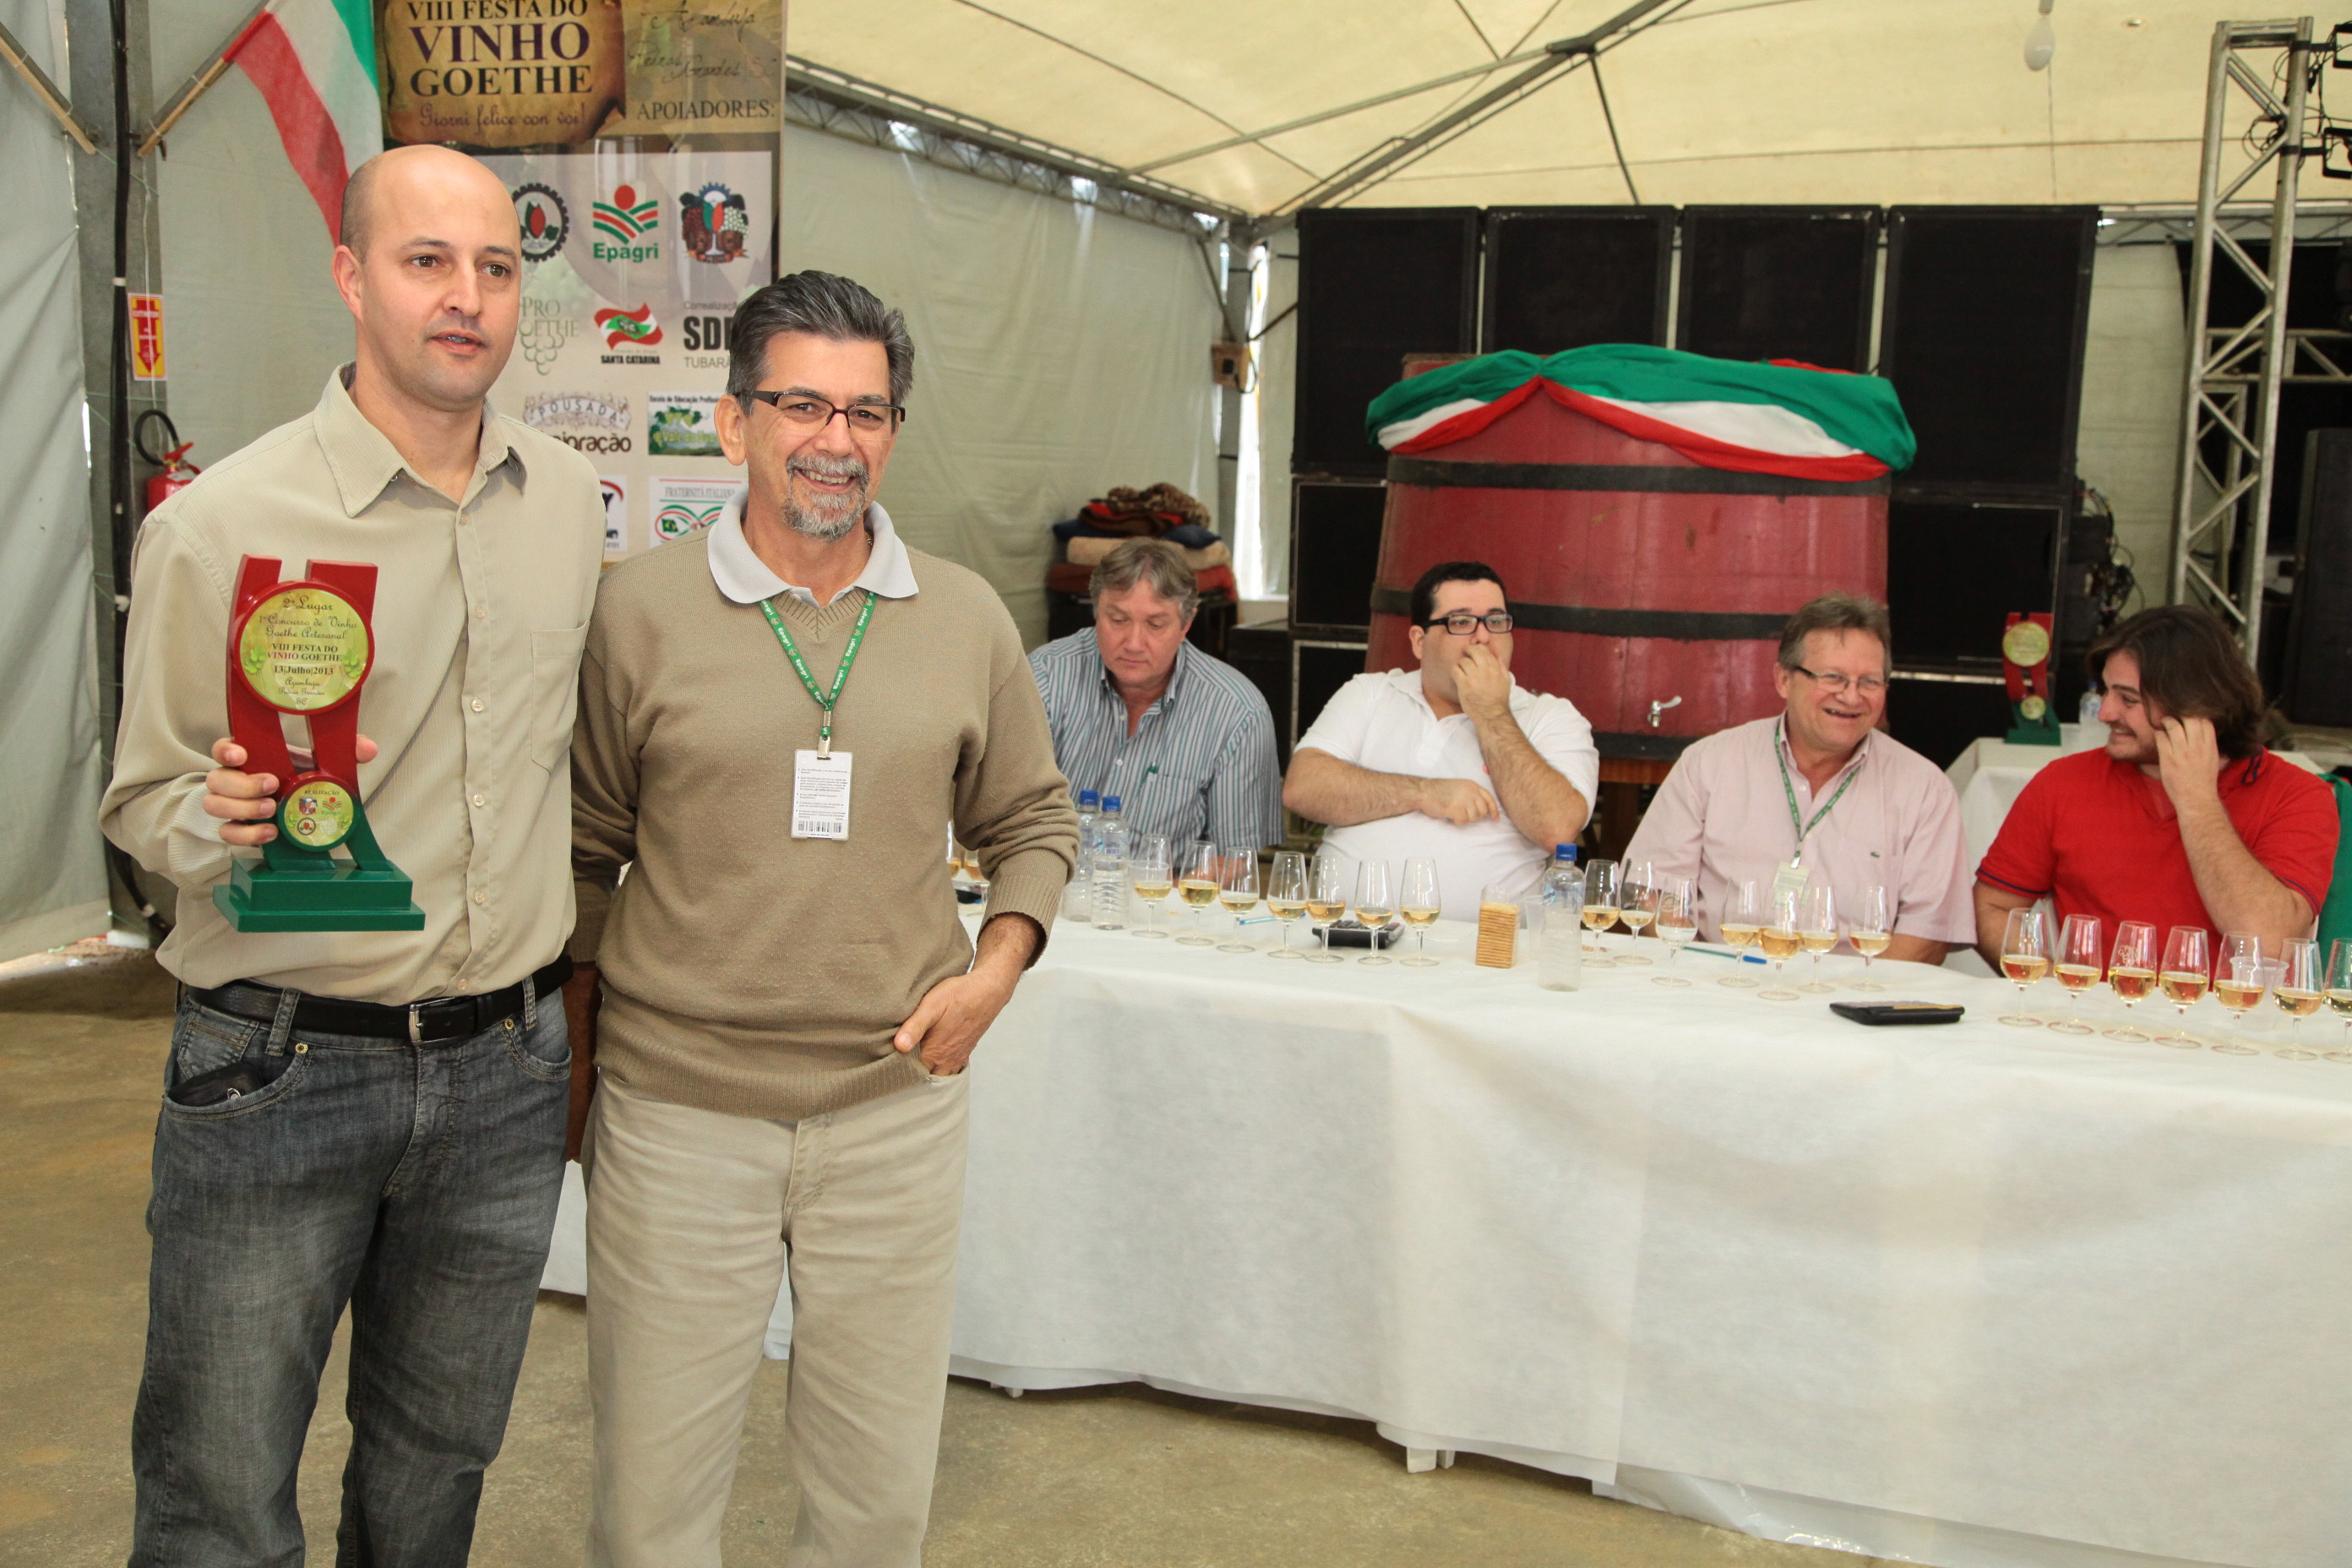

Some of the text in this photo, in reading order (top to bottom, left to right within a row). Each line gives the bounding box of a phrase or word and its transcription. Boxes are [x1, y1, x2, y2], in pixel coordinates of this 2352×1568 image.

[408, 0, 589, 21] VIII FESTA DO
[410, 21, 590, 64] VINHO
[411, 65, 593, 96] GOETHE
[420, 103, 470, 128] Giorni
[477, 103, 516, 133] felice
[522, 113, 549, 126] con
[637, 99, 776, 121] APOIADORES:
[593, 242, 659, 262] Epagri
[521, 296, 561, 318] PRO
[601, 355, 661, 365] SANTA CATARINA
[537, 399, 619, 422] POUSADA
[296, 595, 334, 616] Lugar
[267, 612, 310, 627] Concurso
[313, 618, 323, 627] de
[328, 615, 357, 629] Vinho
[858, 607, 868, 627] Epagri
[265, 625, 347, 640] Goethe Artesanal
[777, 627, 792, 647] Epagri
[267, 651, 342, 662] VINHO GOETHE
[272, 643, 290, 651] VIII
[292, 644, 322, 652] FESTA
[845, 638, 857, 657] Epagri
[795, 658, 809, 679] Epagri
[833, 669, 845, 690] Epagri
